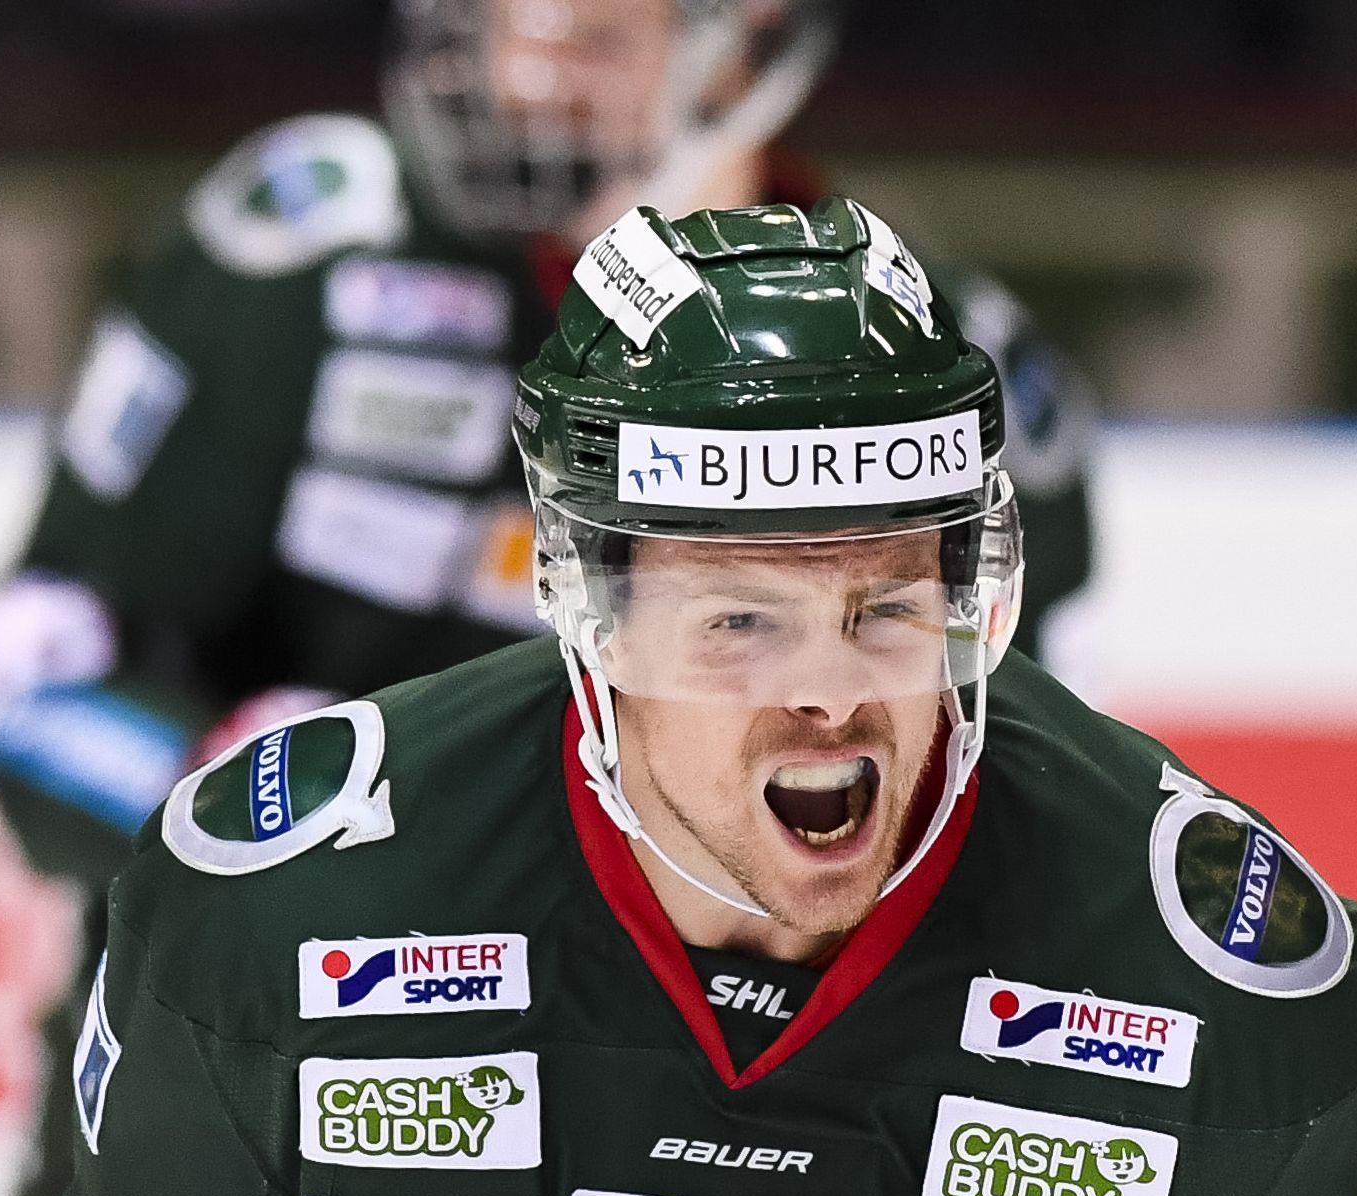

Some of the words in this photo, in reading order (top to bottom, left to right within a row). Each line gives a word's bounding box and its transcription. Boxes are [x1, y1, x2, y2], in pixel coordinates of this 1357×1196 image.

[700, 428, 968, 498] BJURFORS
[256, 727, 289, 833] VOLVO
[1228, 833, 1274, 949] VOLVO
[401, 943, 503, 975] INTER
[403, 975, 503, 1004] SPORT
[706, 974, 794, 1021] SHL
[1066, 1002, 1168, 1045] INTER
[1063, 1037, 1164, 1073] SPORT
[322, 1081, 452, 1117] CASH
[324, 1117, 490, 1153] BUDDY
[955, 1126, 1087, 1181] CASH
